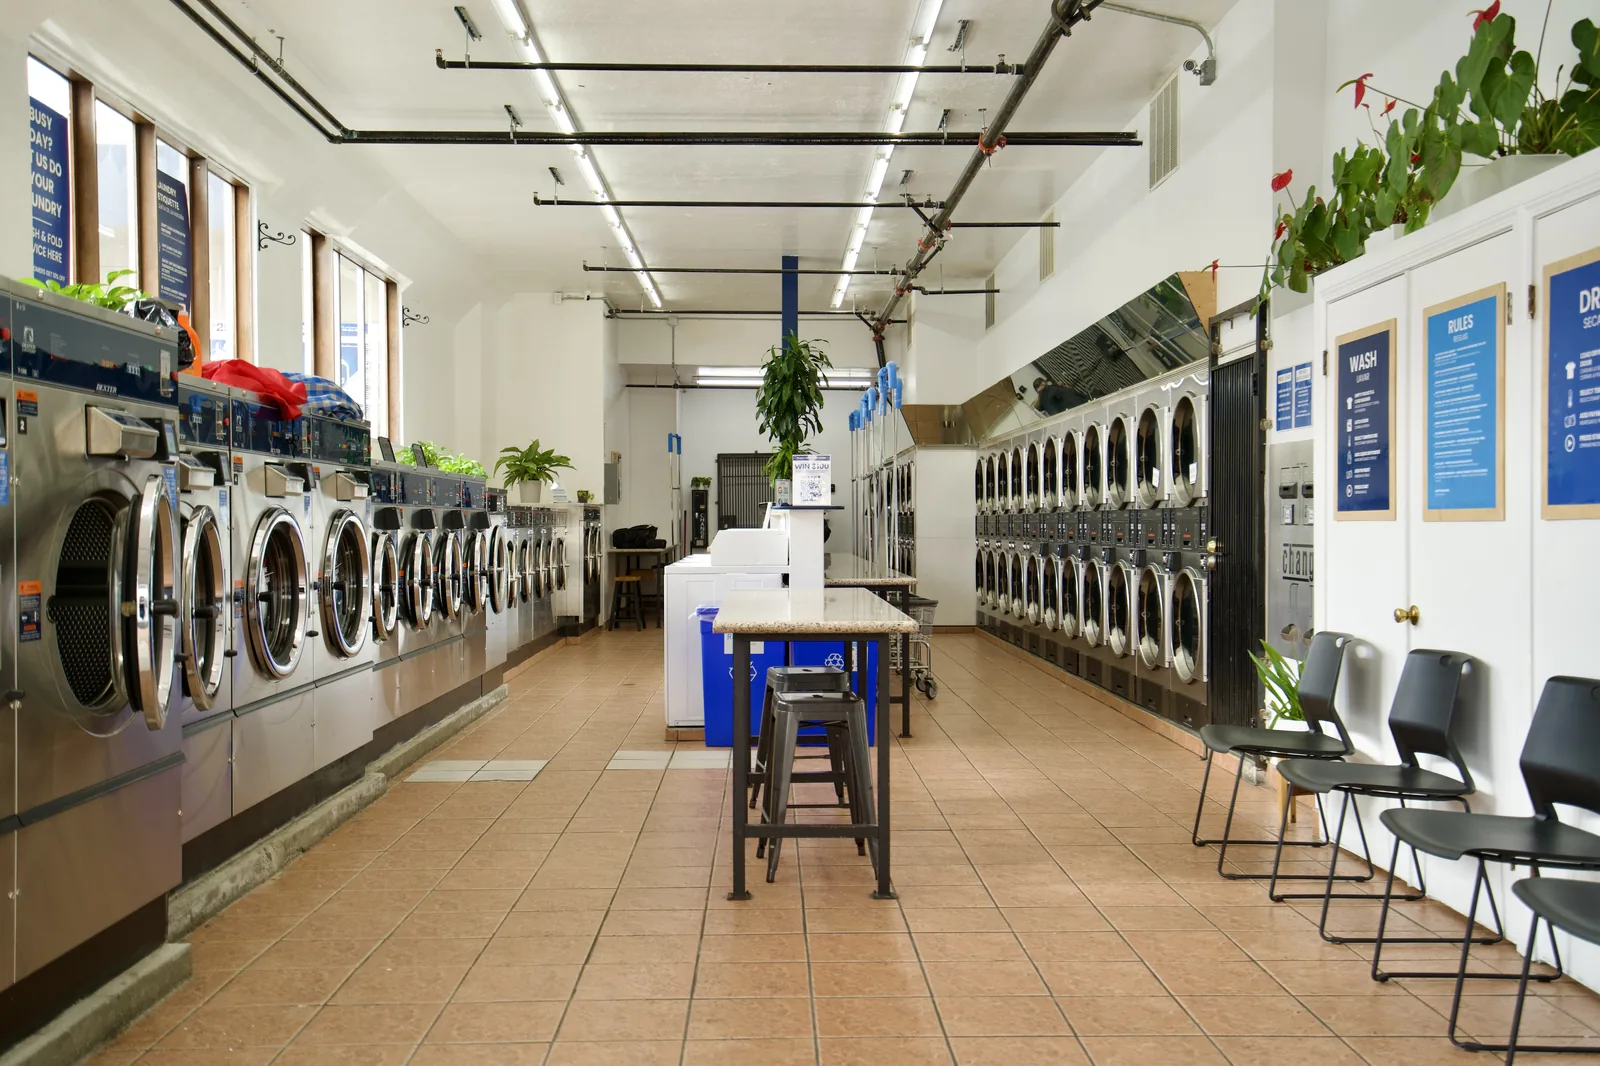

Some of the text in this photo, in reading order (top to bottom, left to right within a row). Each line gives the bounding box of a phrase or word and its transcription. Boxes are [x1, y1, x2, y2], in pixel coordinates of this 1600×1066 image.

[49, 158, 62, 177] DO
[47, 233, 63, 248] FOLD
[1448, 313, 1474, 334] RULES
[1349, 350, 1377, 373] WASH
[95, 383, 118, 394] DEXTER
[20, 420, 25, 432] 2
